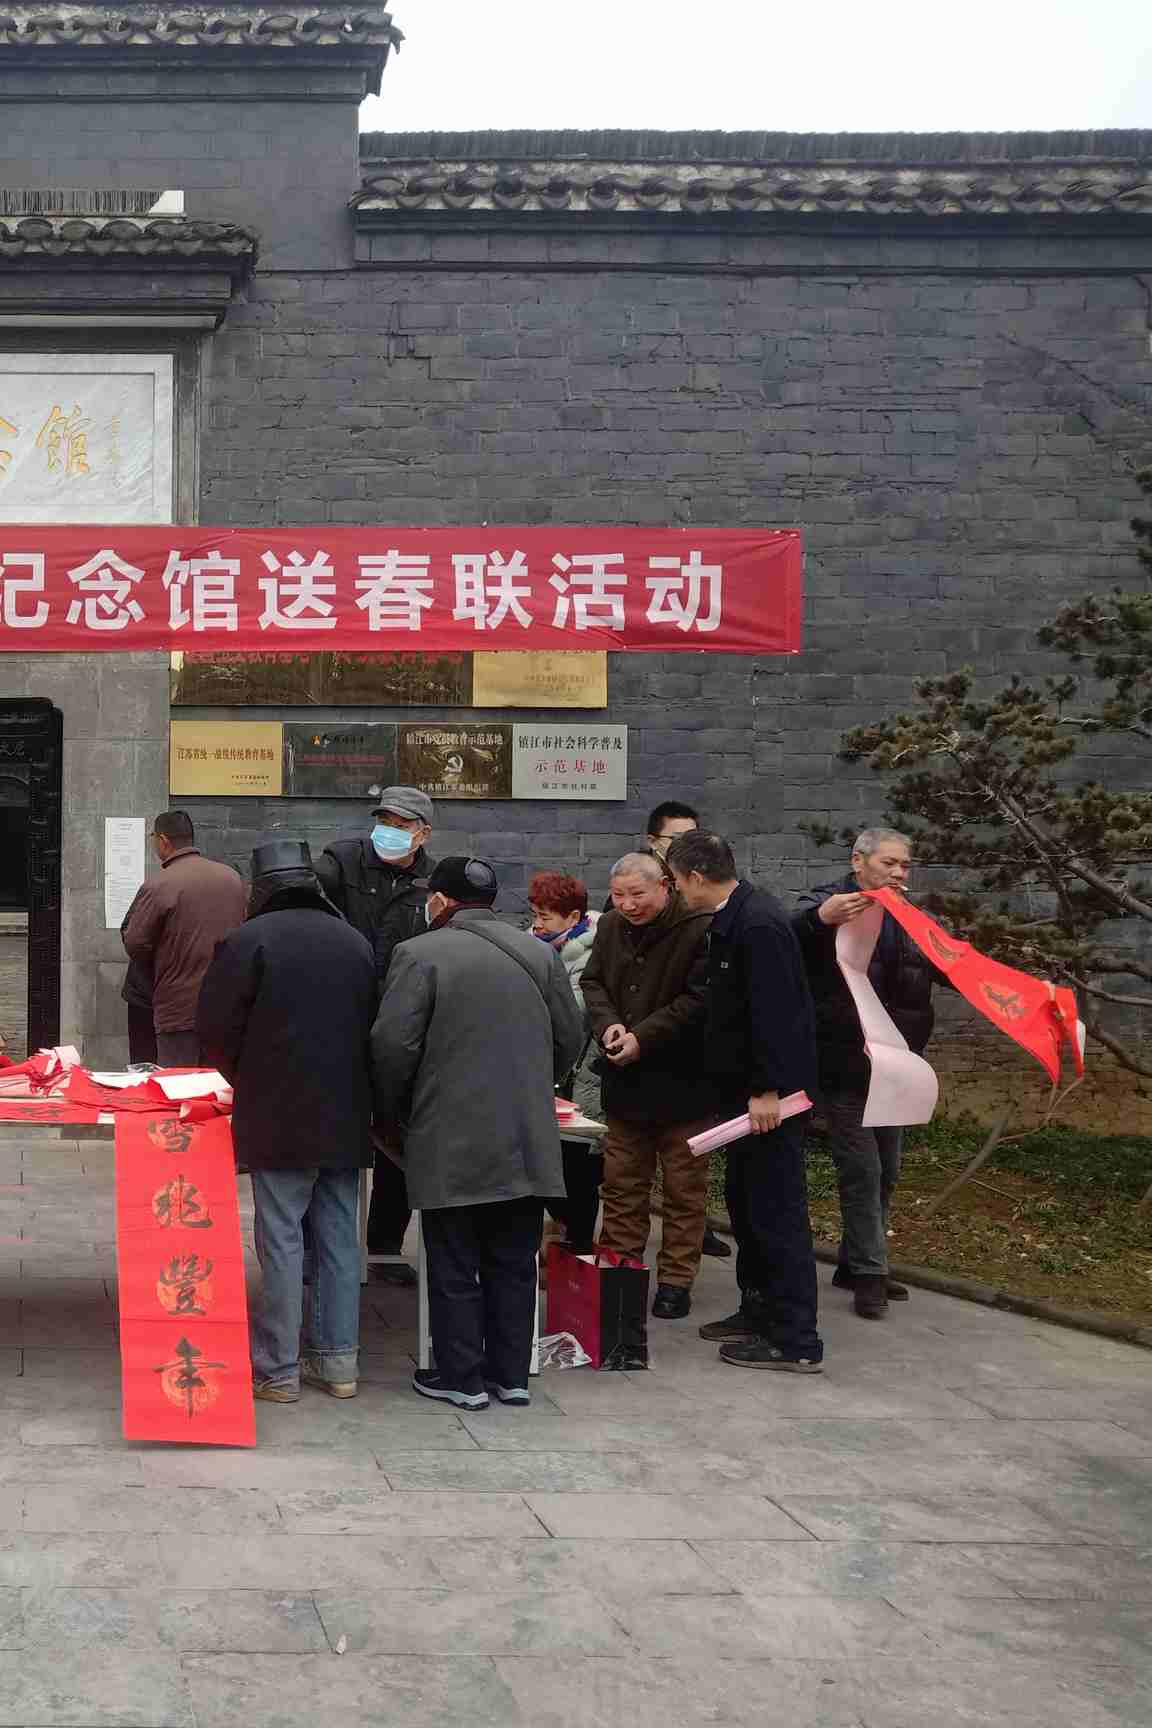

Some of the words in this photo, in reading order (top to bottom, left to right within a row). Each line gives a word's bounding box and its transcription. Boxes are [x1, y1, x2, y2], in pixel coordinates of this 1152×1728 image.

[519, 735, 624, 750] 镇江市社会科学普及
